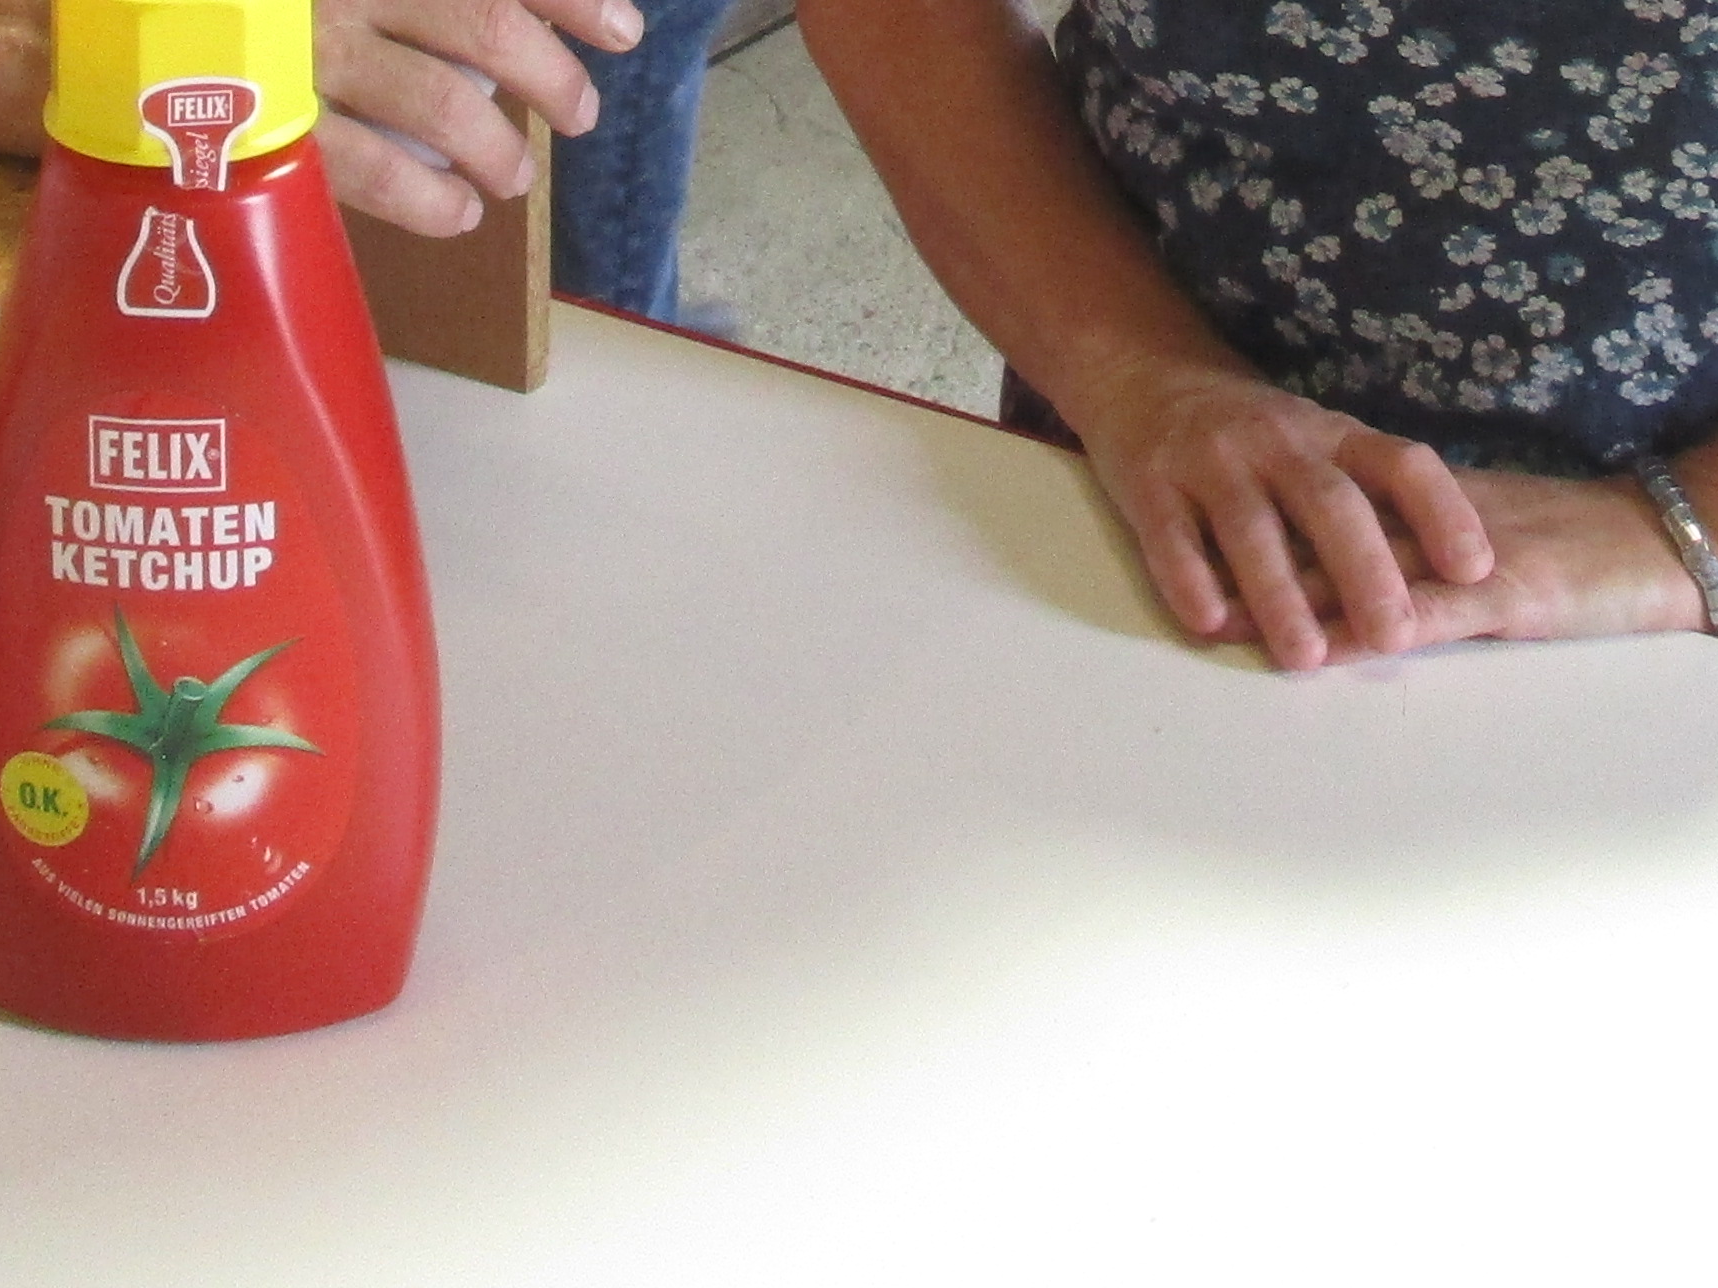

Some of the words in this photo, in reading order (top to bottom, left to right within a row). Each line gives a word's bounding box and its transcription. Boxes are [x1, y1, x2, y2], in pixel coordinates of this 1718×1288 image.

[173, 95, 228, 121] FELIX
[98, 424, 215, 481] FELIX
[44, 495, 277, 546] TOMATEN
[51, 541, 274, 591] KETCHUP
[19, 781, 69, 817] O.K.
[31, 857, 56, 884] AUS
[248, 859, 312, 912] TOMATEN
[135, 887, 168, 908] 1,5
[171, 887, 200, 910] kg
